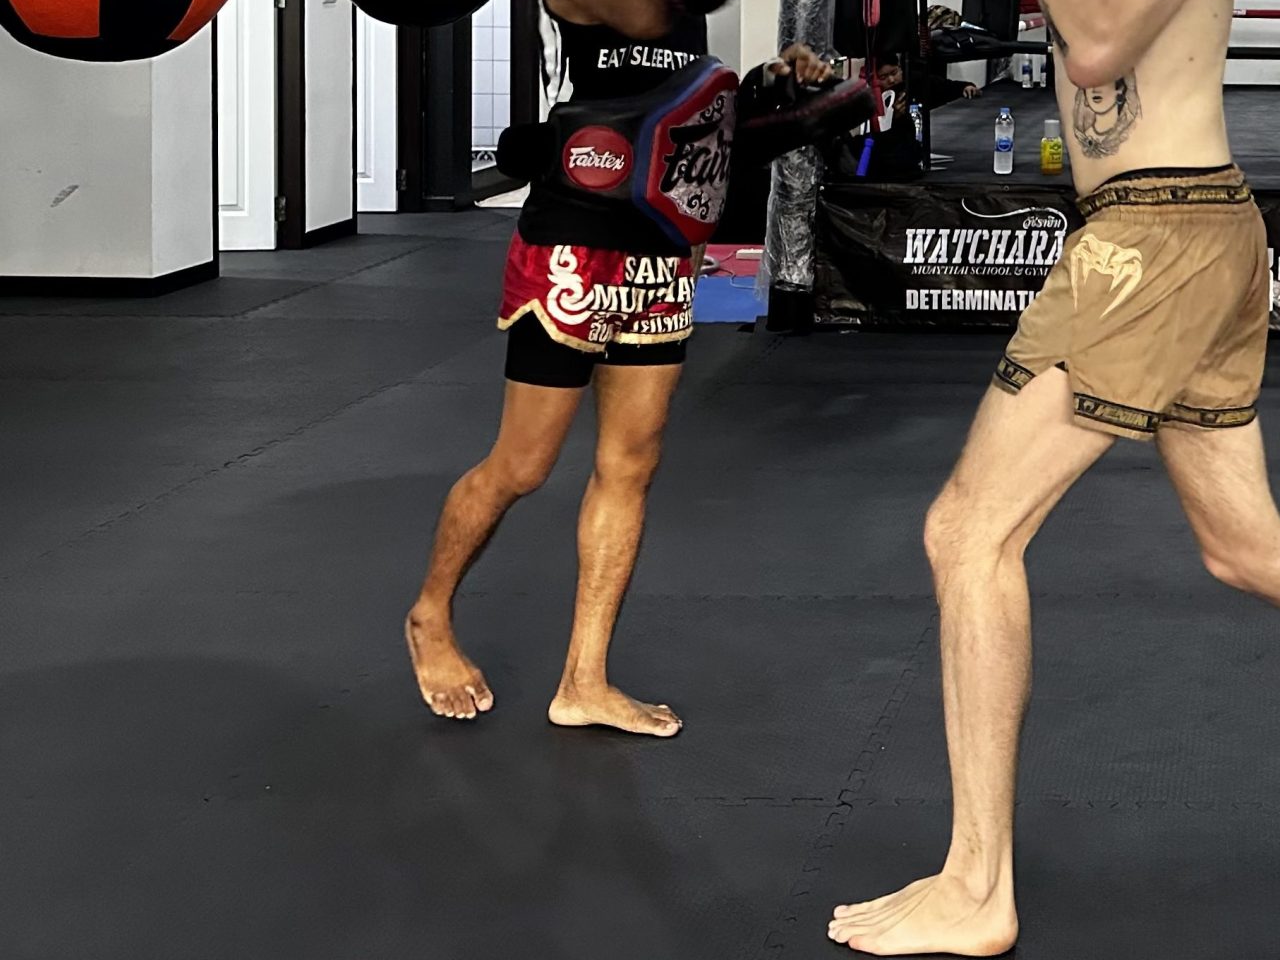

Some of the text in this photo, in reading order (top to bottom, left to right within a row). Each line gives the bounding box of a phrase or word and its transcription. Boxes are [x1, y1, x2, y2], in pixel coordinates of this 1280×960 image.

[569, 146, 625, 171] Fairtex
[903, 228, 1067, 266] WATCHARA
[911, 265, 1049, 278] MUAYTHAI SCHOOL & GYM
[905, 289, 1041, 312] DETERMINATI
